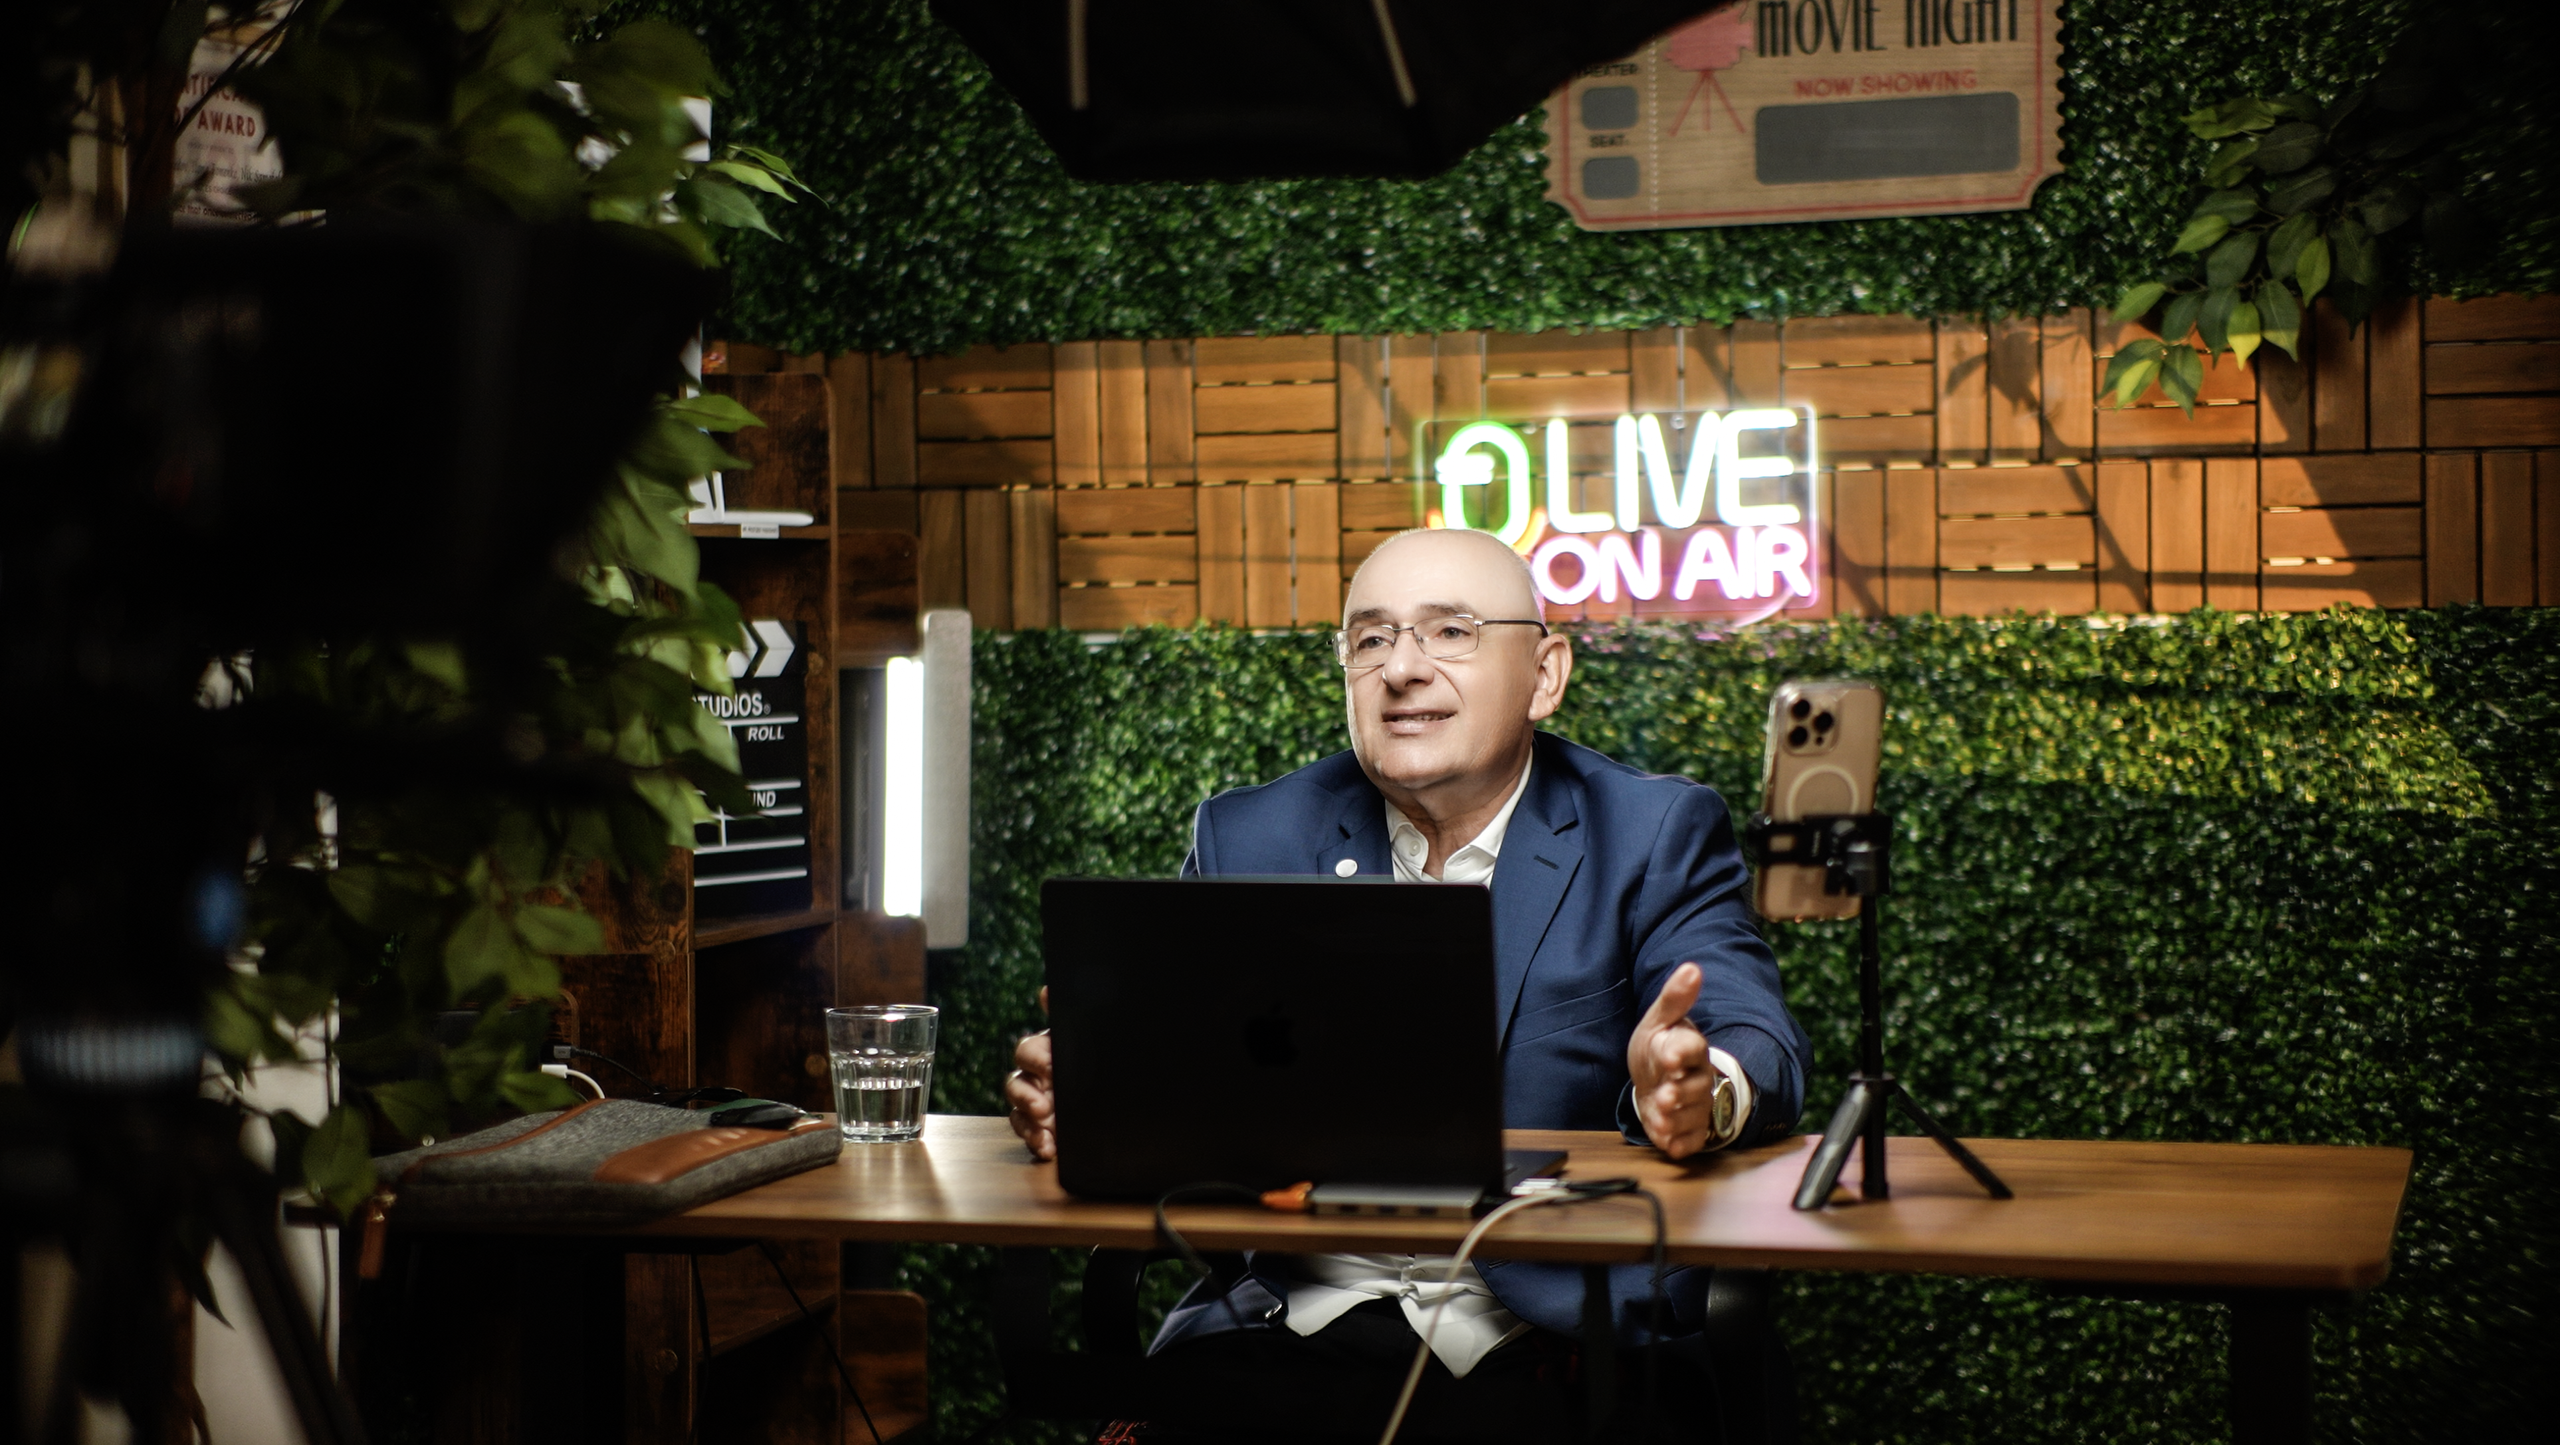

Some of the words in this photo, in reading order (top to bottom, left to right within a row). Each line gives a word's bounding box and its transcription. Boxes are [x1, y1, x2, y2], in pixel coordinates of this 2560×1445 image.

[1794, 77, 1854, 97] NOW
[1861, 69, 1978, 94] SHOWING
[198, 110, 256, 137] AWARD
[1546, 409, 1801, 534] LIVE
[1532, 526, 1662, 605] ON
[1674, 525, 1812, 601] AIR
[692, 692, 764, 718] TUDIOS
[747, 725, 785, 742] ROLL
